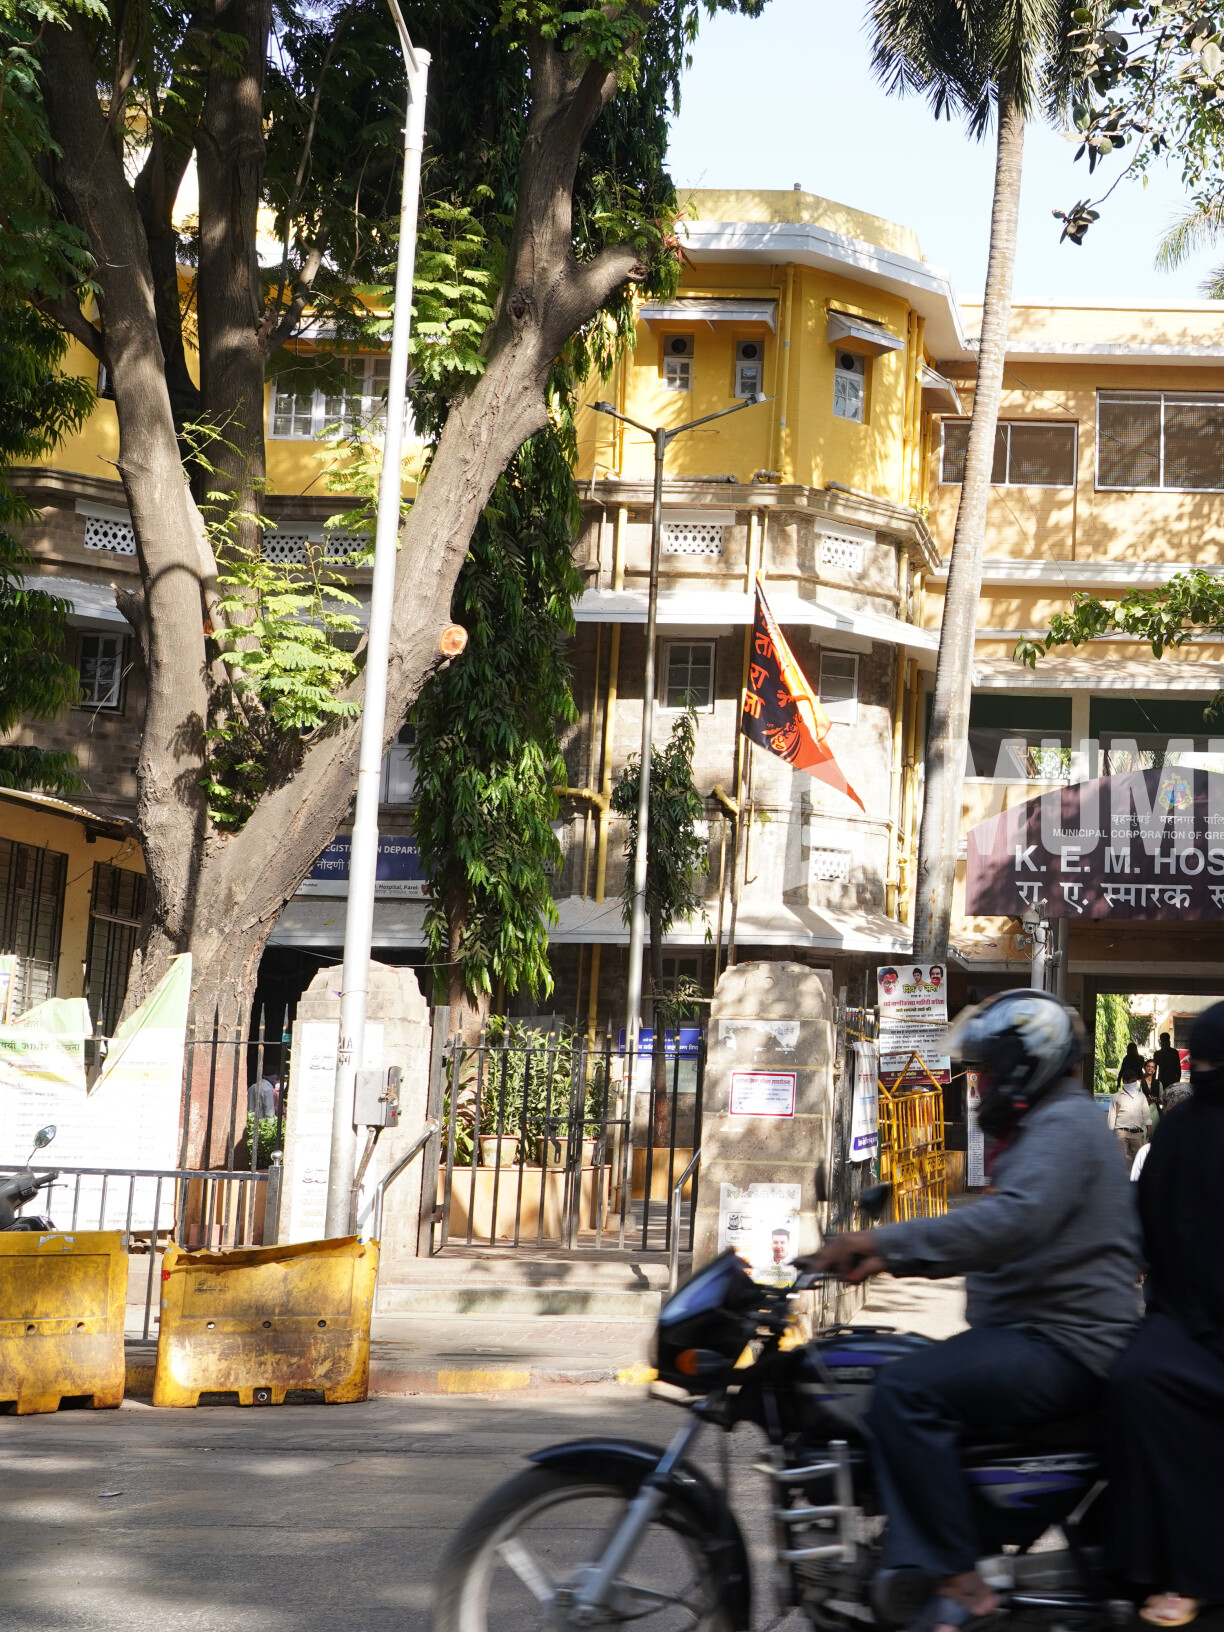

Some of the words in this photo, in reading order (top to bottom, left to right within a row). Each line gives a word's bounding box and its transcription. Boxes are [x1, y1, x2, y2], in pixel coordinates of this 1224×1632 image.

[1159, 814, 1196, 826] महानगर
[1052, 828, 1109, 839] MUNICIPAL
[1111, 829, 1186, 840] CORPORATION
[1188, 831, 1203, 840] OF
[1014, 844, 1046, 872] K.
[1060, 845, 1091, 873] E.
[1104, 846, 1141, 874] M.
[1060, 882, 1089, 913] ए.
[1100, 882, 1193, 909] स्मारक
